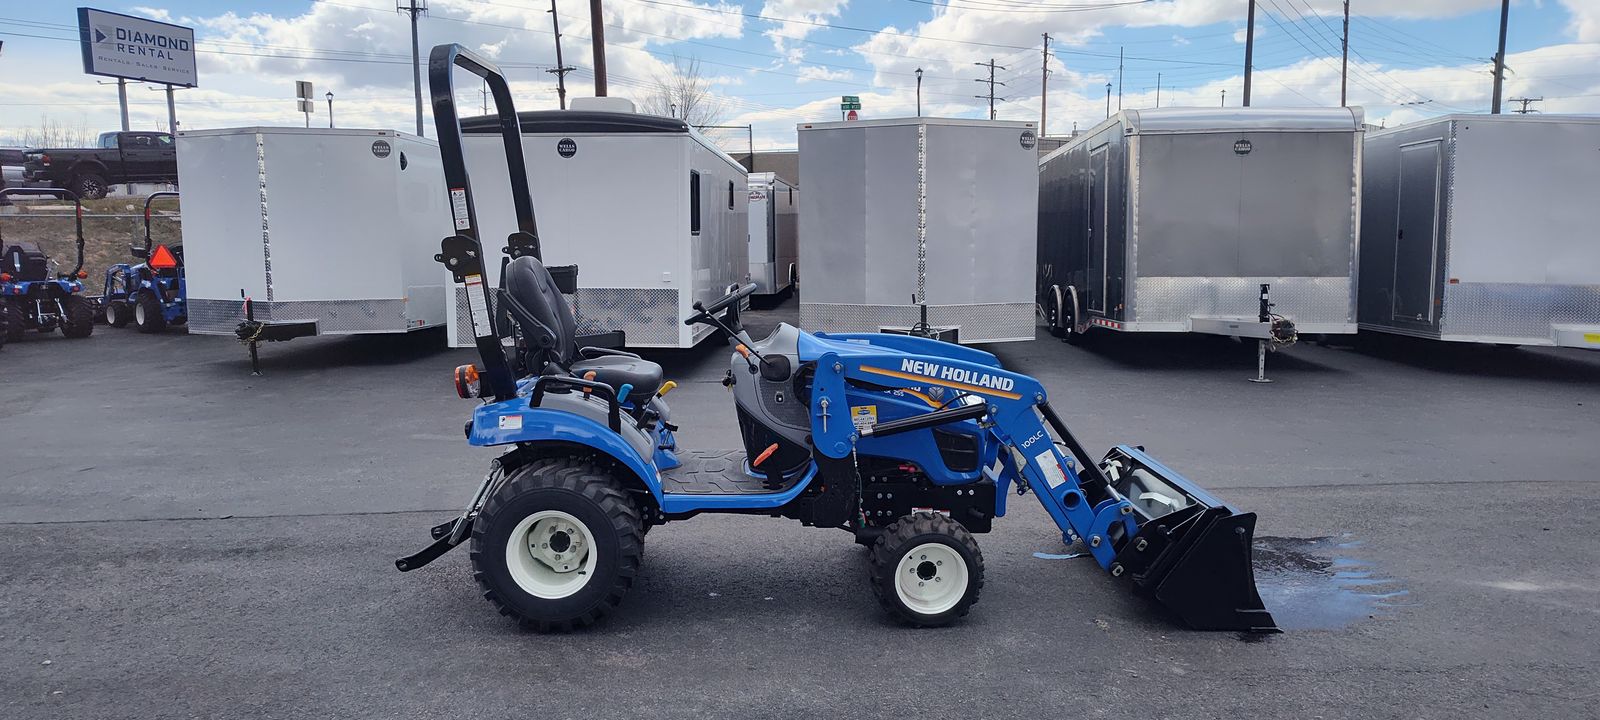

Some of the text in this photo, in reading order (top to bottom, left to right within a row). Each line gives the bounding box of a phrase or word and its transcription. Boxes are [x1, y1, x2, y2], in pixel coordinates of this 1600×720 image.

[116, 27, 189, 51] DIAMOND
[117, 43, 174, 61] RENTAL
[901, 358, 1014, 392] NEW HOLLAND
[1021, 430, 1044, 449] 100LC
